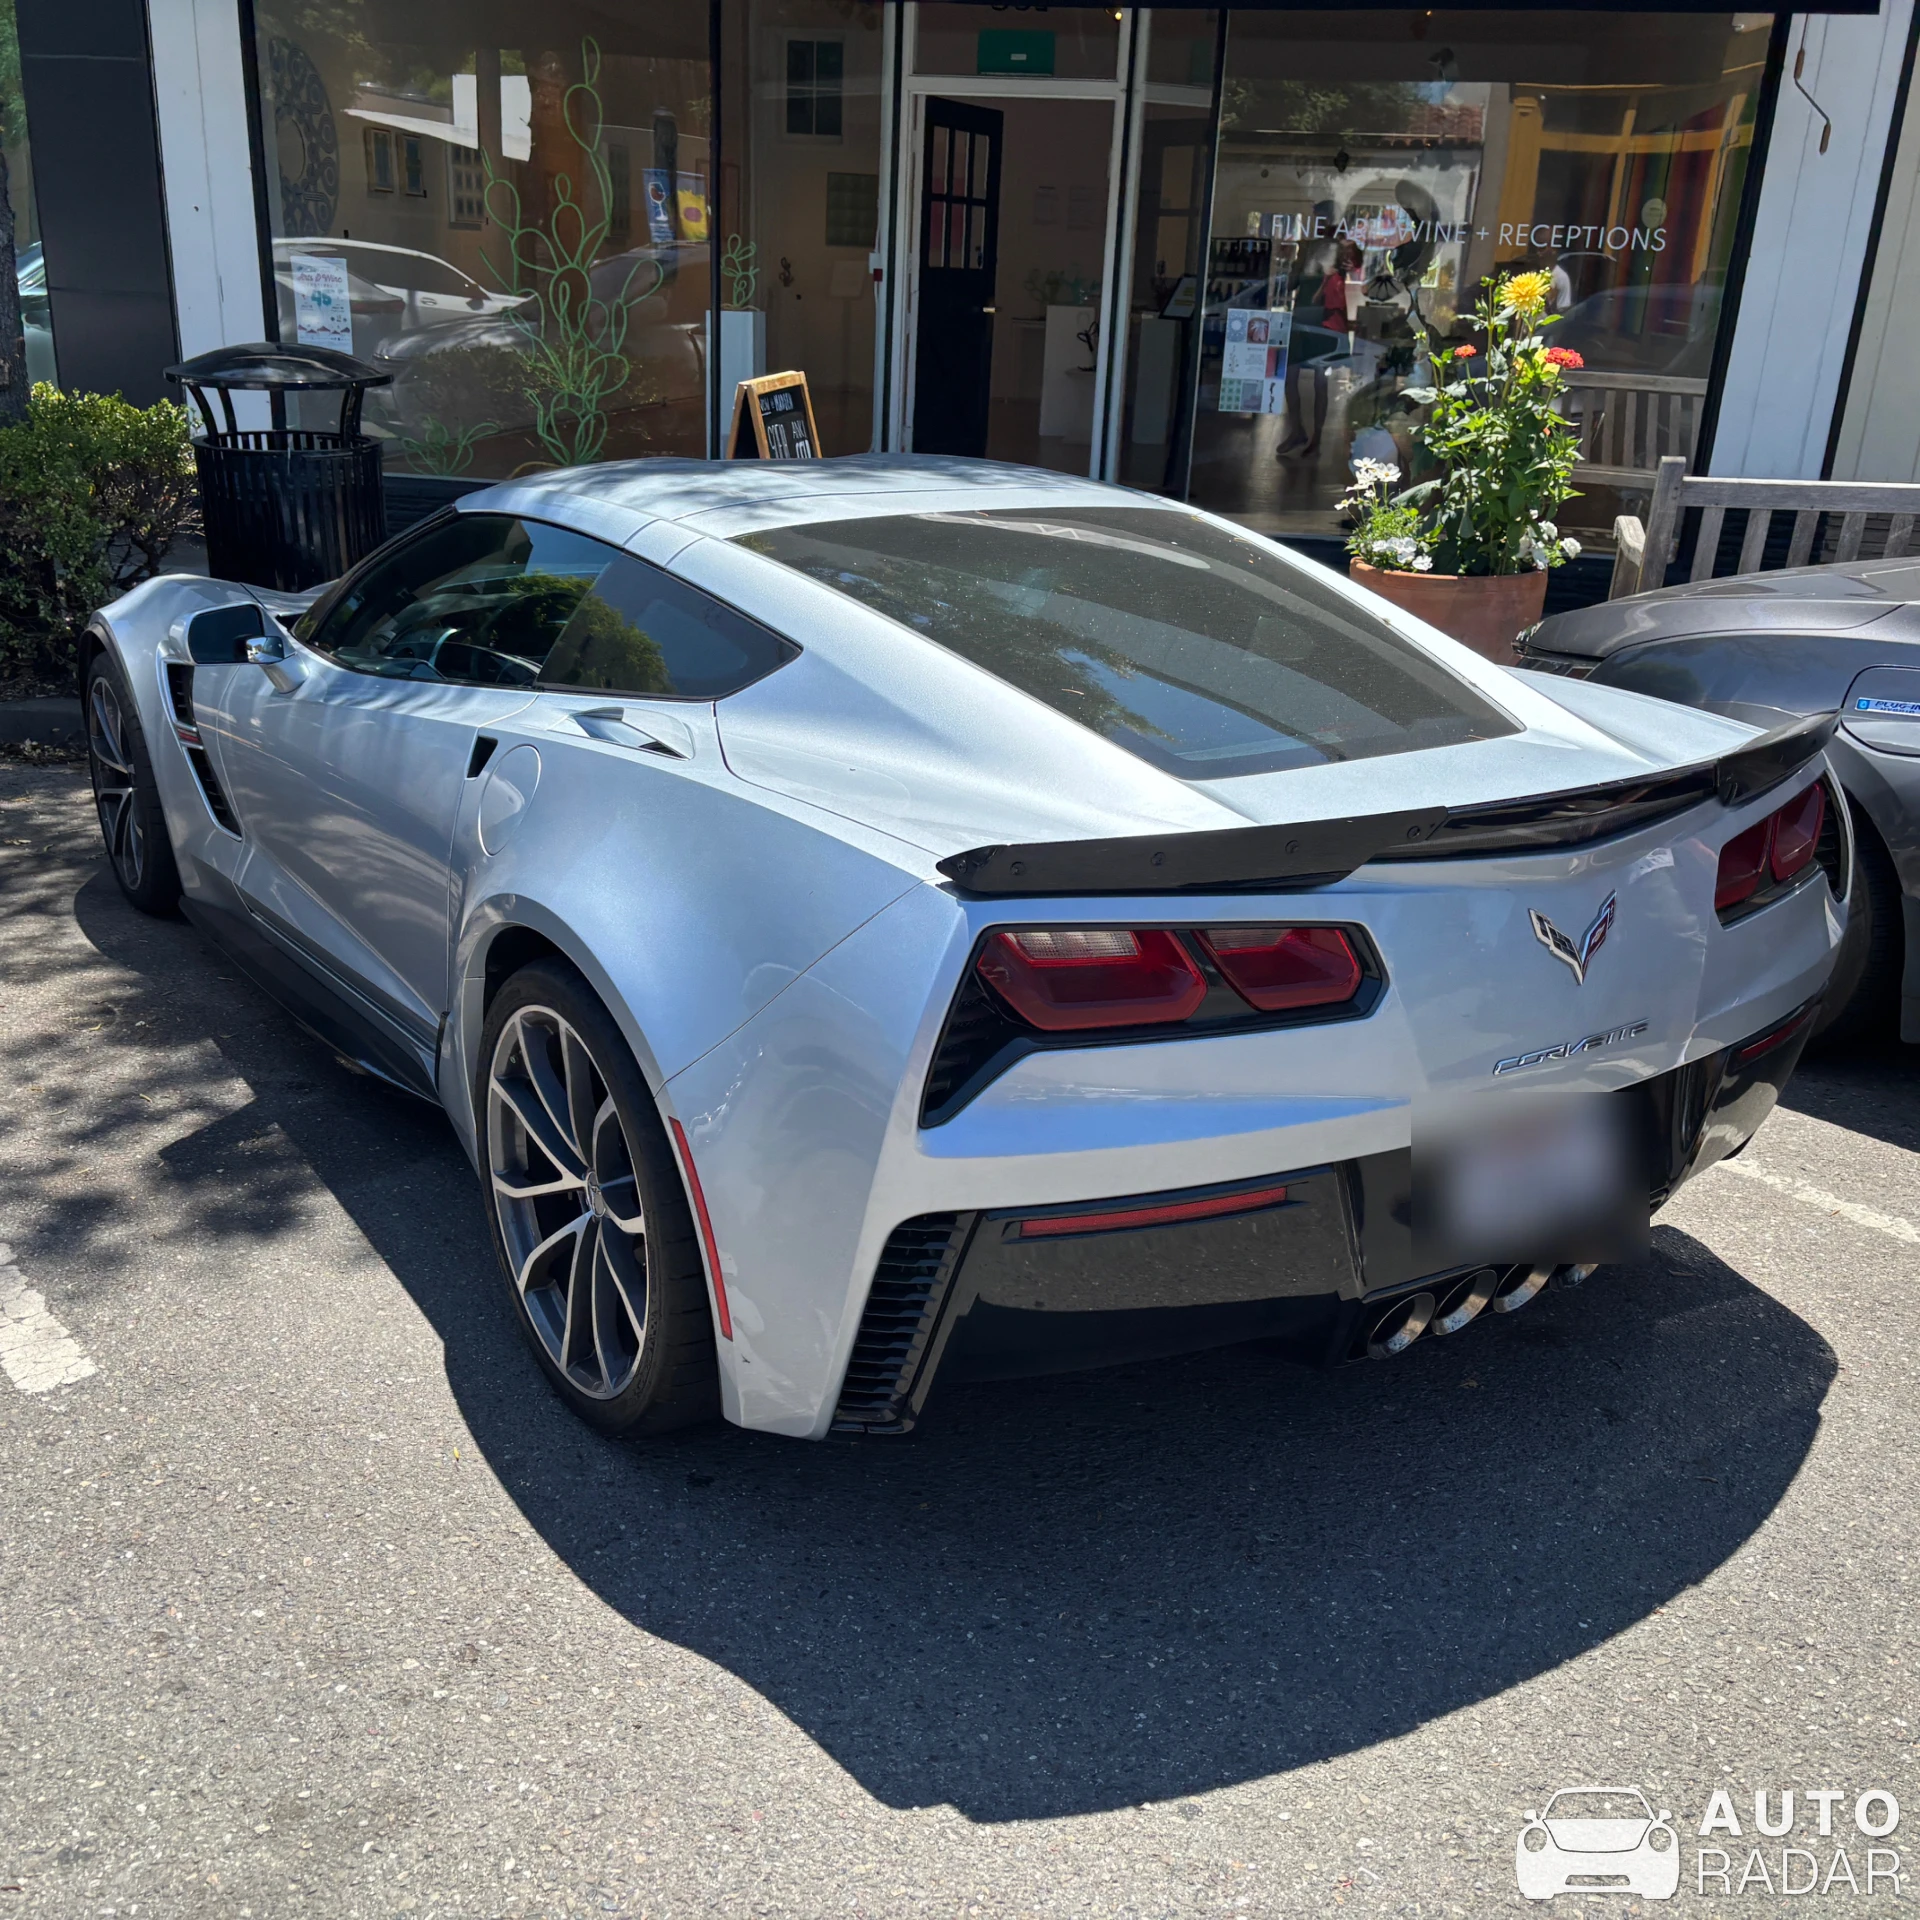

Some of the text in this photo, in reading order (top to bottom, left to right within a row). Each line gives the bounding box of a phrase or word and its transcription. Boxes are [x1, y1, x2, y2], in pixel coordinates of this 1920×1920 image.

[1272, 214, 1327, 239] FINE
[1397, 219, 1468, 244] WINE
[1475, 226, 1489, 240] +
[1498, 223, 1667, 252] RECEPTIONS
[1493, 1017, 1650, 1076] CORVETTE
